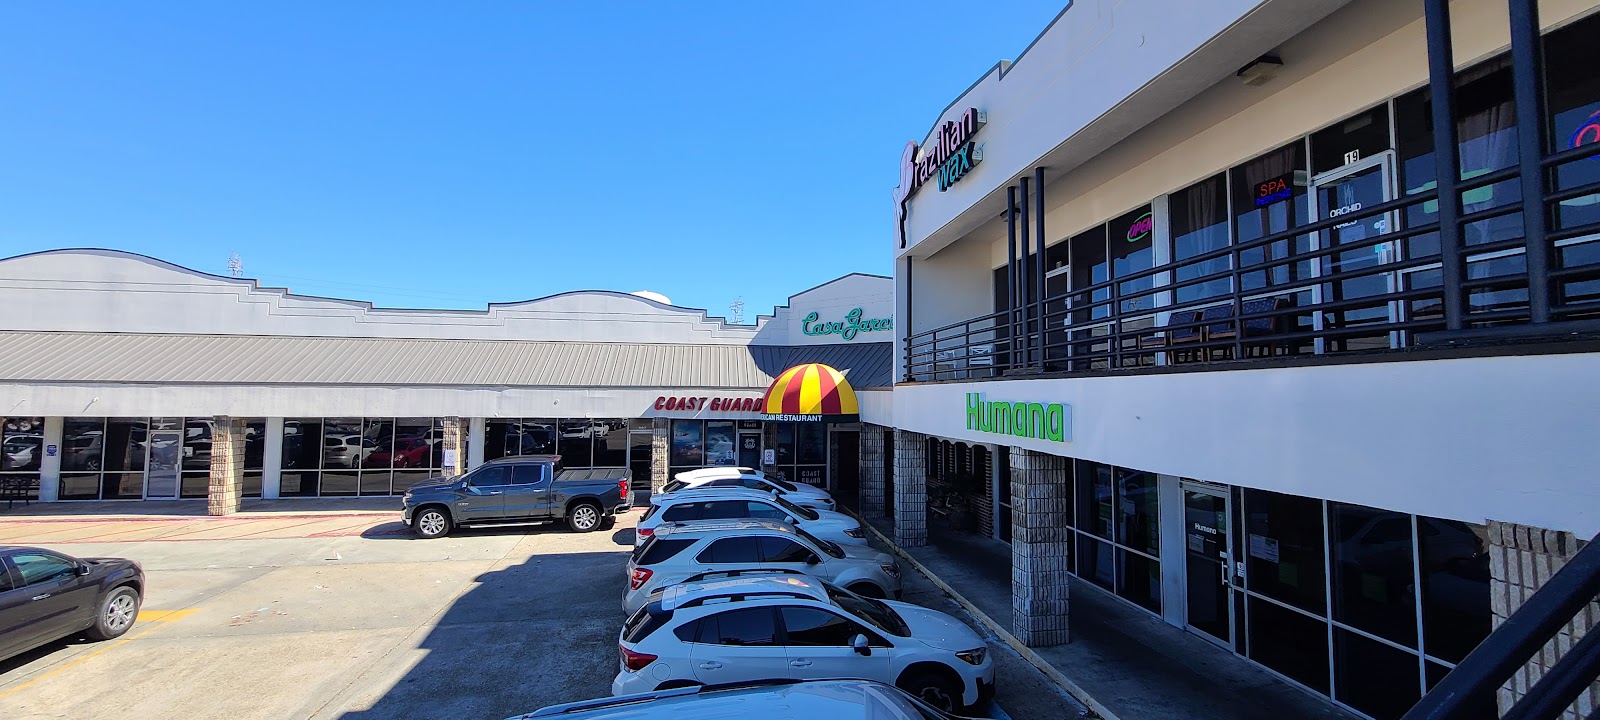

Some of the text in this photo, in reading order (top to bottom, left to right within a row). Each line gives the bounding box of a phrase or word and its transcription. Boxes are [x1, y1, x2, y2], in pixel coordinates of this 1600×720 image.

[899, 107, 975, 199] Brazilian
[1345, 150, 1359, 164] 19
[937, 142, 974, 192] wax
[1260, 178, 1287, 197] SPA
[1330, 202, 1362, 218] ORCHID
[1129, 216, 1152, 238] OPEN
[802, 307, 893, 341] Casa Garci
[653, 396, 764, 412] COAST GUARD
[776, 414, 822, 422] RESTAURANT
[966, 392, 1066, 442] Humana
[1194, 522, 1217, 535] Humana
